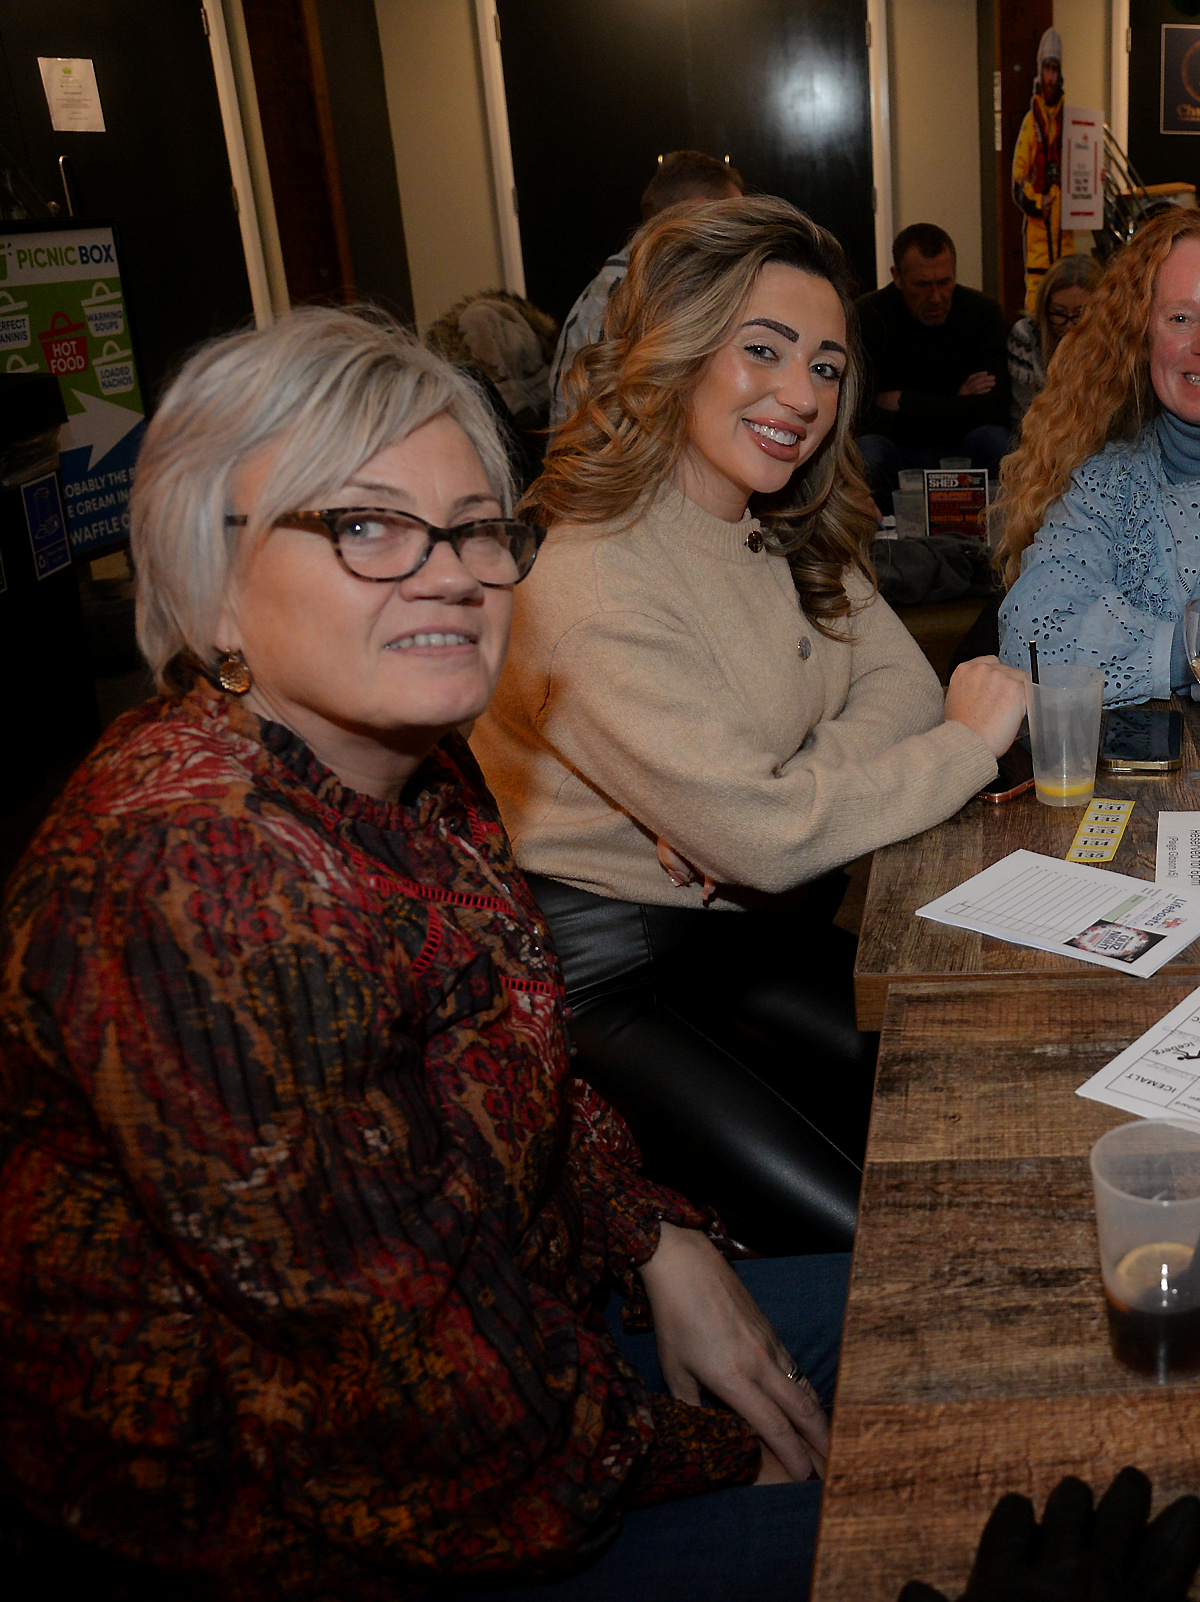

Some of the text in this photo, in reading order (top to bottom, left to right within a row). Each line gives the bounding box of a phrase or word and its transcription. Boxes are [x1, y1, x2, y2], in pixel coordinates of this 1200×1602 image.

[52, 340, 78, 358] HOT
[50, 355, 85, 375] FOOD
[100, 365, 131, 380] LOADED
[101, 376, 134, 389] NACHOS
[64, 475, 106, 499] OBABLY
[106, 470, 127, 486] THE
[928, 479, 960, 488] SHED
[76, 493, 117, 516] CREAM
[69, 516, 121, 547] WAFFLE
[1097, 803, 1122, 811] 131
[1093, 815, 1121, 823] 132
[1088, 826, 1115, 834] 133
[1083, 838, 1109, 847] 134
[1077, 851, 1104, 859] 135
[1144, 897, 1187, 927] Lifeboats
[1097, 930, 1122, 951] NIGHT
[1109, 934, 1129, 951] QUIZ
[1151, 1041, 1195, 1056] Iceberg
[1124, 1072, 1177, 1093] ICEMALT
